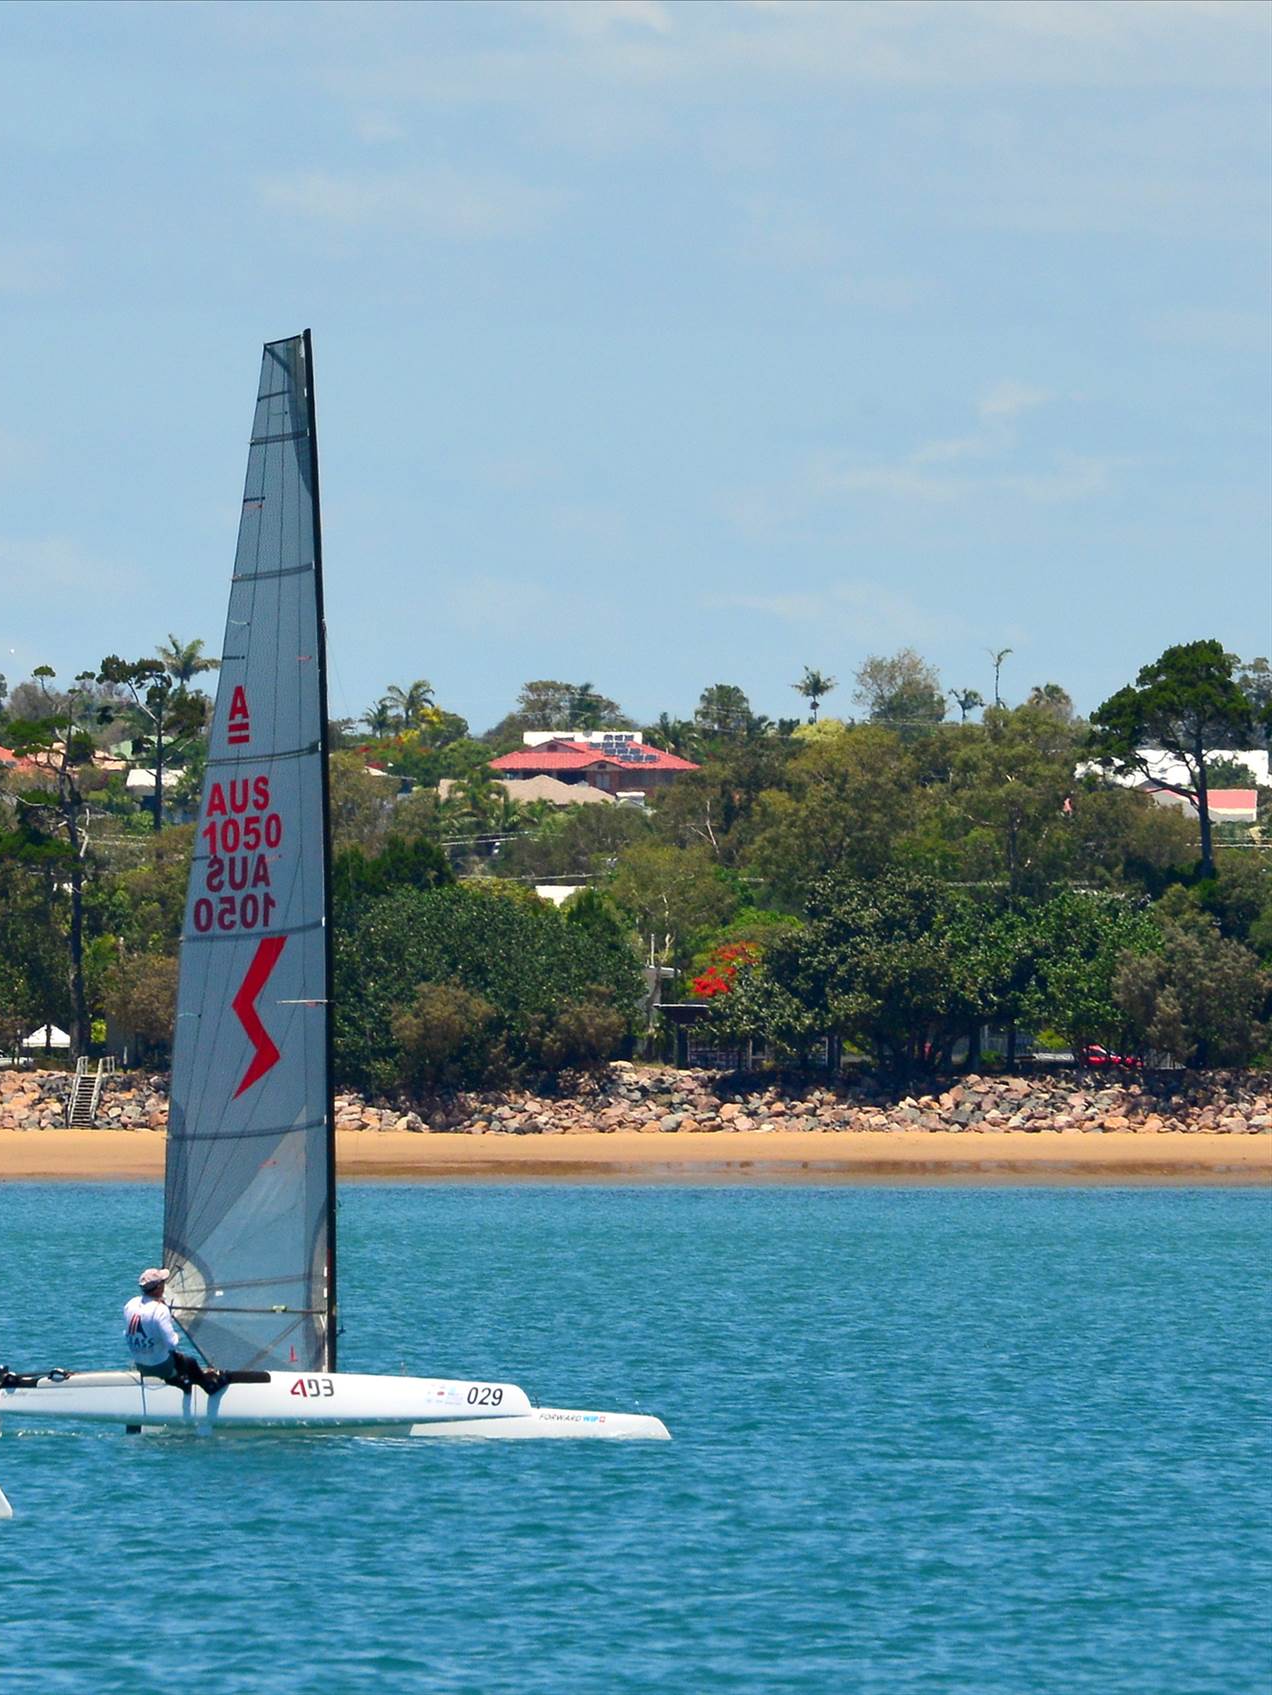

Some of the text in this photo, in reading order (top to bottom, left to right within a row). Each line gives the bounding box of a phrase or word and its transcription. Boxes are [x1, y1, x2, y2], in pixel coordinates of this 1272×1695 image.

[229, 685, 249, 720] A
[206, 775, 270, 817] AUS
[202, 813, 282, 855] 1050
[467, 1386, 503, 1406] 029
